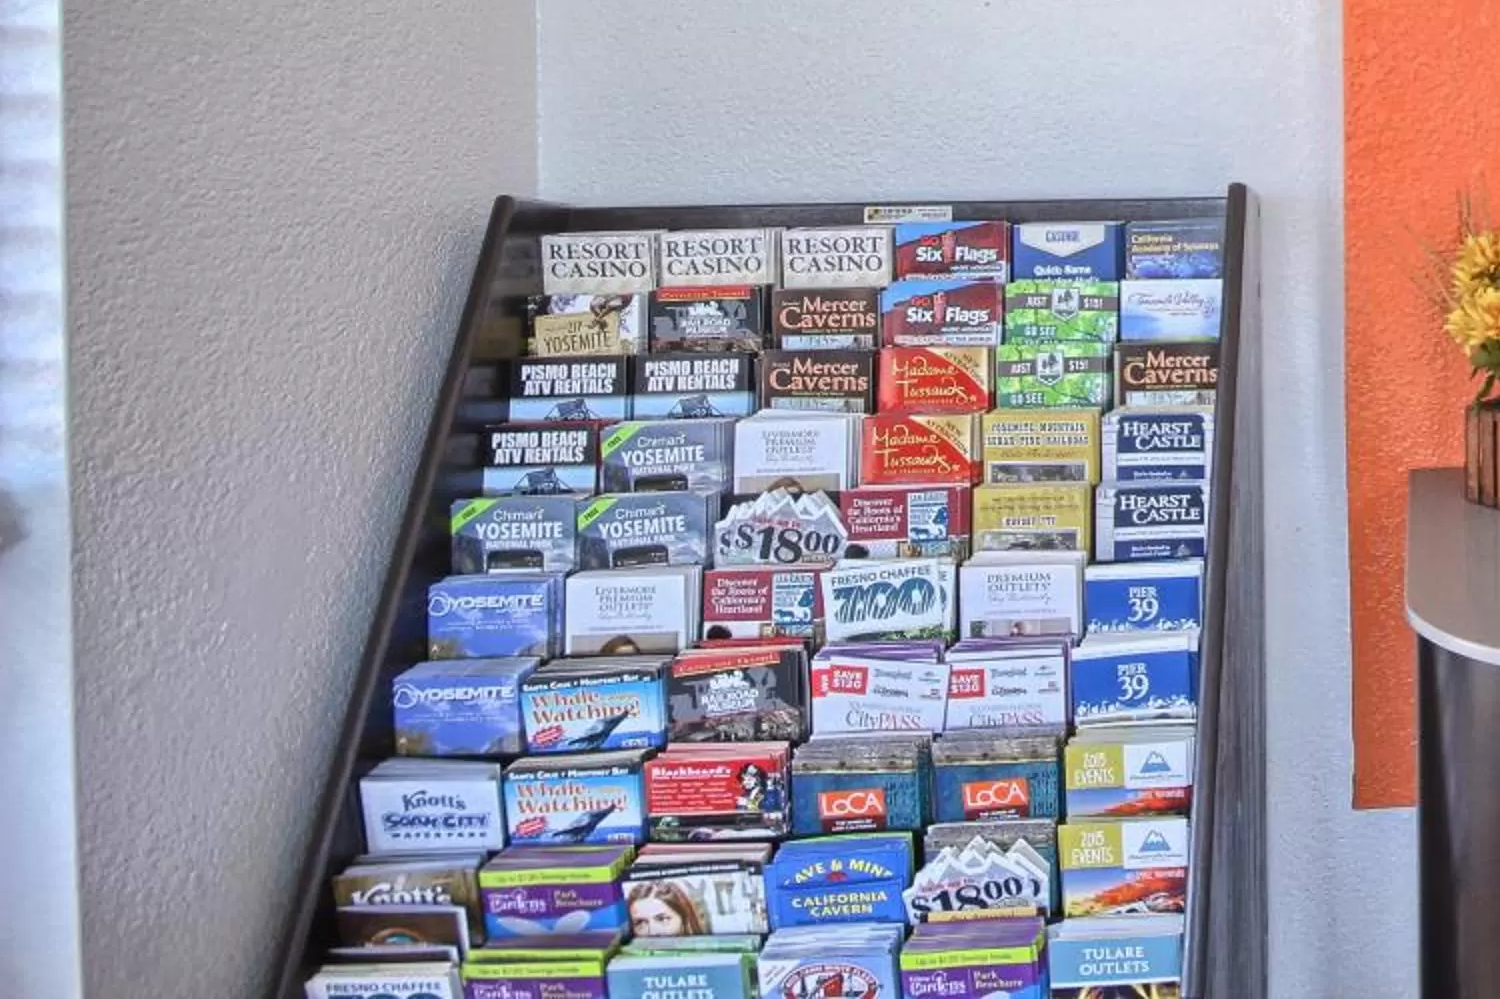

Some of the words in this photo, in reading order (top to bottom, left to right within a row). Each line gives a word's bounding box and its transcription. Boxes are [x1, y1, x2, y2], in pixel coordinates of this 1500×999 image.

[550, 242, 646, 260] RESORT
[666, 237, 763, 258] RESORT
[787, 236, 884, 255] RESORT
[916, 246, 943, 262] Six
[955, 245, 998, 264] Flags
[551, 260, 647, 279] CASINO
[667, 257, 762, 277] CASINO
[789, 254, 884, 274] CASINO
[802, 296, 868, 313] Mercer
[779, 306, 877, 330] Caverns
[906, 306, 934, 323] Six
[945, 306, 990, 326] Flags
[542, 332, 611, 354] YOSEMITE
[644, 360, 691, 378] PISMO
[693, 358, 740, 376] BEACH
[793, 356, 860, 376] Mercer
[1146, 350, 1211, 369] Mercer
[521, 364, 569, 381] PISMO
[570, 362, 617, 380] BEACH
[769, 367, 869, 391] Caverns
[1123, 362, 1218, 385] Caverns
[523, 380, 551, 396] ATV
[553, 378, 614, 395] RENTALS
[647, 375, 675, 392] ATV
[677, 374, 736, 391] RENTALS
[1122, 421, 1193, 438] HEARST
[491, 431, 539, 450] PISMO
[541, 430, 588, 448] BEACH
[1135, 435, 1202, 450] CASTLE
[494, 447, 522, 465] ATV
[524, 446, 585, 464] RENTALS
[621, 445, 705, 467] YOSEMITE
[1120, 494, 1192, 511] HEARST
[1132, 507, 1202, 524] CASTLE
[475, 521, 563, 540] YOSEMITE
[598, 515, 686, 539] YOSEMITE
[831, 572, 877, 587] FRESNO
[879, 565, 931, 580] CHAFFEE
[986, 572, 1052, 583] PREMIUM
[448, 594, 545, 609] YOSEMITE
[1128, 586, 1158, 598] PIER
[1127, 598, 1160, 622] 39
[832, 670, 863, 680] SAVE
[1117, 663, 1148, 676] PIER
[415, 685, 515, 702] YOSEMITE
[1117, 675, 1150, 702] 39
[530, 691, 600, 707] Whale
[1074, 768, 1115, 786] EVENTS
[516, 782, 586, 799] Whale
[402, 790, 468, 812] Knott's
[1081, 830, 1105, 847] 2015
[1071, 846, 1114, 866] EVENTS
[351, 882, 452, 906] Knott's
[791, 890, 889, 909] CALIFORNIA
[809, 904, 875, 919] CAVERN
[1083, 947, 1146, 961] TULARE
[1079, 960, 1150, 977] OUTLETS
[325, 981, 379, 994] FRESNO
[381, 980, 442, 992] CHAFFEE
[643, 975, 709, 989] TULARE
[641, 988, 714, 999] OUTLETS
